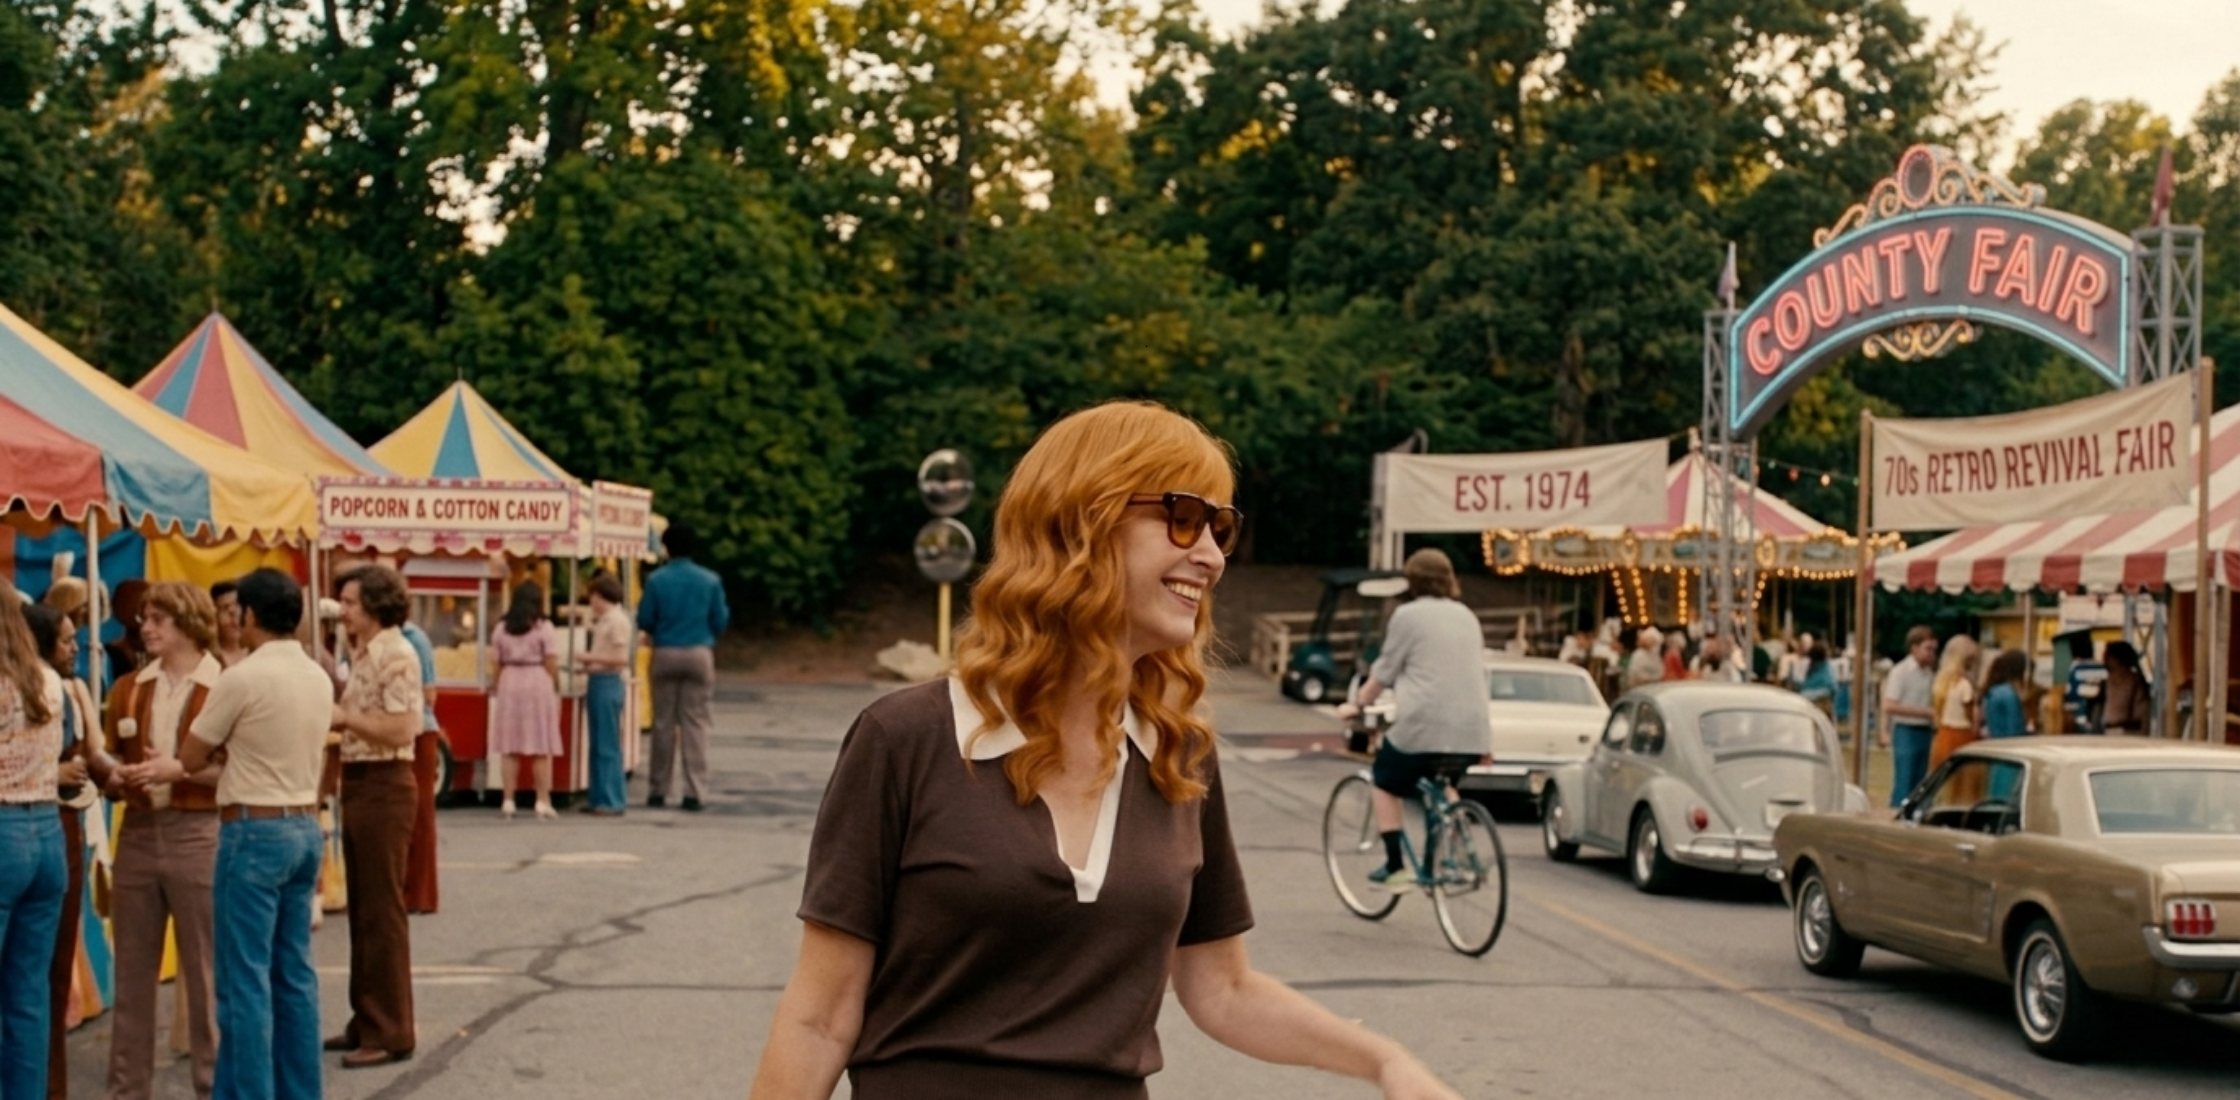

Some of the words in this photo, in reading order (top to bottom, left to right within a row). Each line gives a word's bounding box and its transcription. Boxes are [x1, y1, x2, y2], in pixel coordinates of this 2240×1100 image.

[1746, 227, 1952, 375] COUNTY
[1969, 228, 2109, 336] FAIR
[1884, 456, 1919, 497] 70s
[1926, 448, 1997, 494] RETRO
[2003, 434, 2104, 489] REVIVAL
[2114, 420, 2176, 475] FAIR
[331, 496, 409, 518] POPCORN
[416, 498, 427, 518] &
[433, 499, 500, 520] COTTON
[506, 500, 562, 522] CANDY
[1455, 474, 1511, 511] EST.
[1524, 470, 1591, 511] 1974
